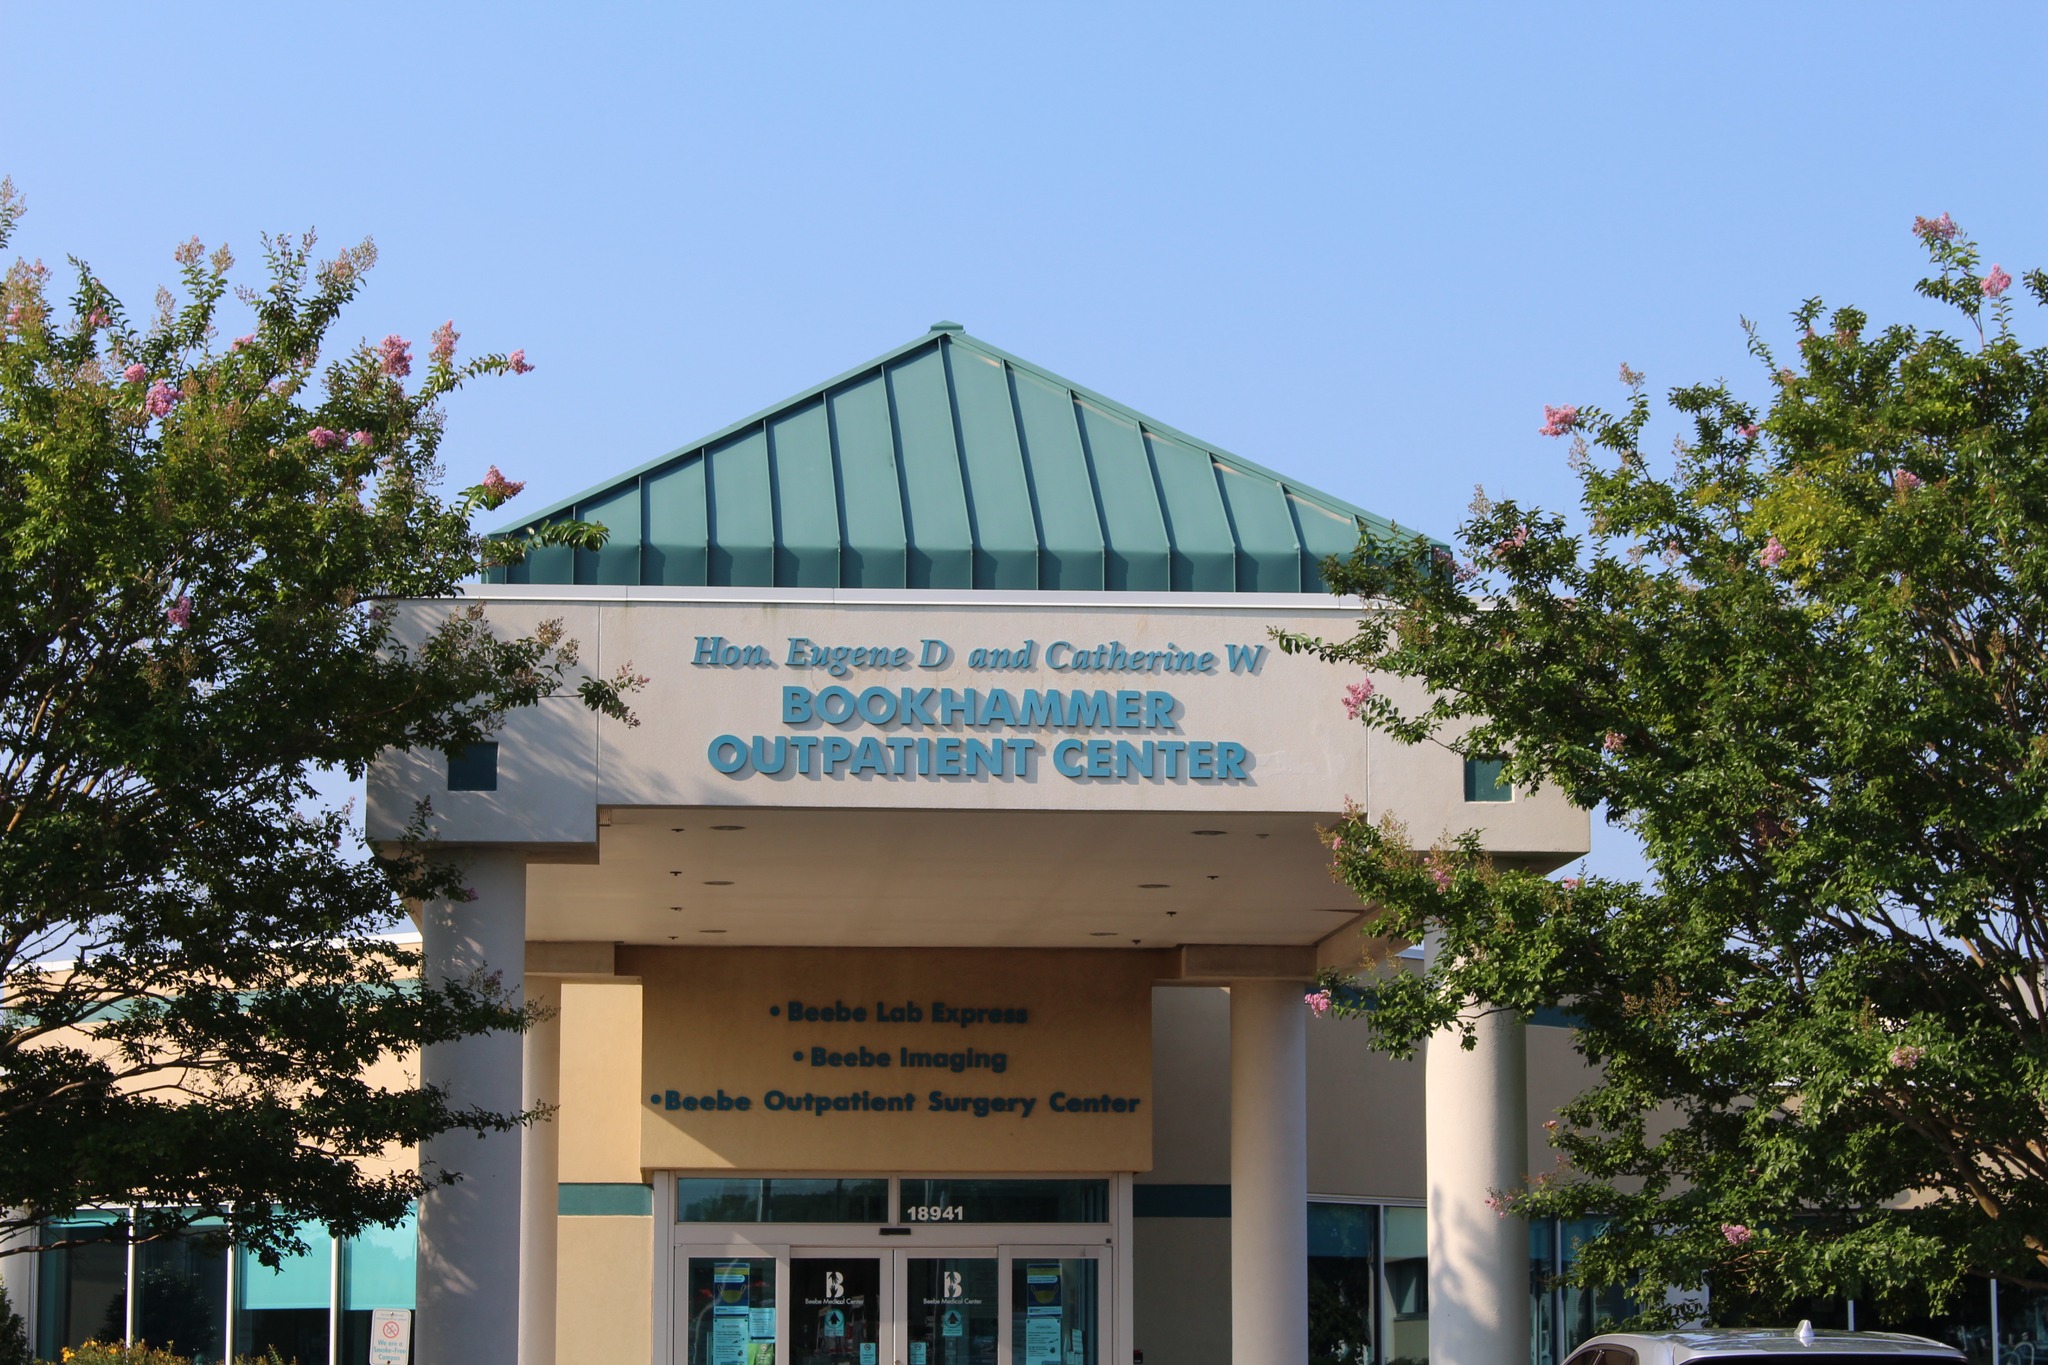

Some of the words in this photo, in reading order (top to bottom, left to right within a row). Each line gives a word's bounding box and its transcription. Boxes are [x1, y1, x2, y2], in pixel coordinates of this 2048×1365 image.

[690, 636, 772, 667] Hon.
[784, 636, 908, 676] Eugene
[917, 638, 949, 668] D
[967, 639, 1033, 669] and
[1045, 641, 1214, 673] Catherine
[1224, 643, 1264, 673] W
[781, 685, 1176, 729] BOOKHAMMER
[707, 734, 1034, 777] OUTPATIENT
[1053, 738, 1247, 779] CENTER
[787, 1001, 867, 1023] Beebe
[876, 1002, 923, 1023] Lab
[931, 1003, 1029, 1028] Express
[810, 1046, 891, 1068] Beebe
[900, 1047, 1008, 1072] Imaging
[664, 1090, 752, 1112] Beebe
[763, 1090, 916, 1116] Outpatient
[928, 1091, 1037, 1118] Surgery
[1048, 1092, 1141, 1113] Center
[907, 1206, 964, 1221] 18941
[373, 1346, 407, 1354] Smoke-Free
